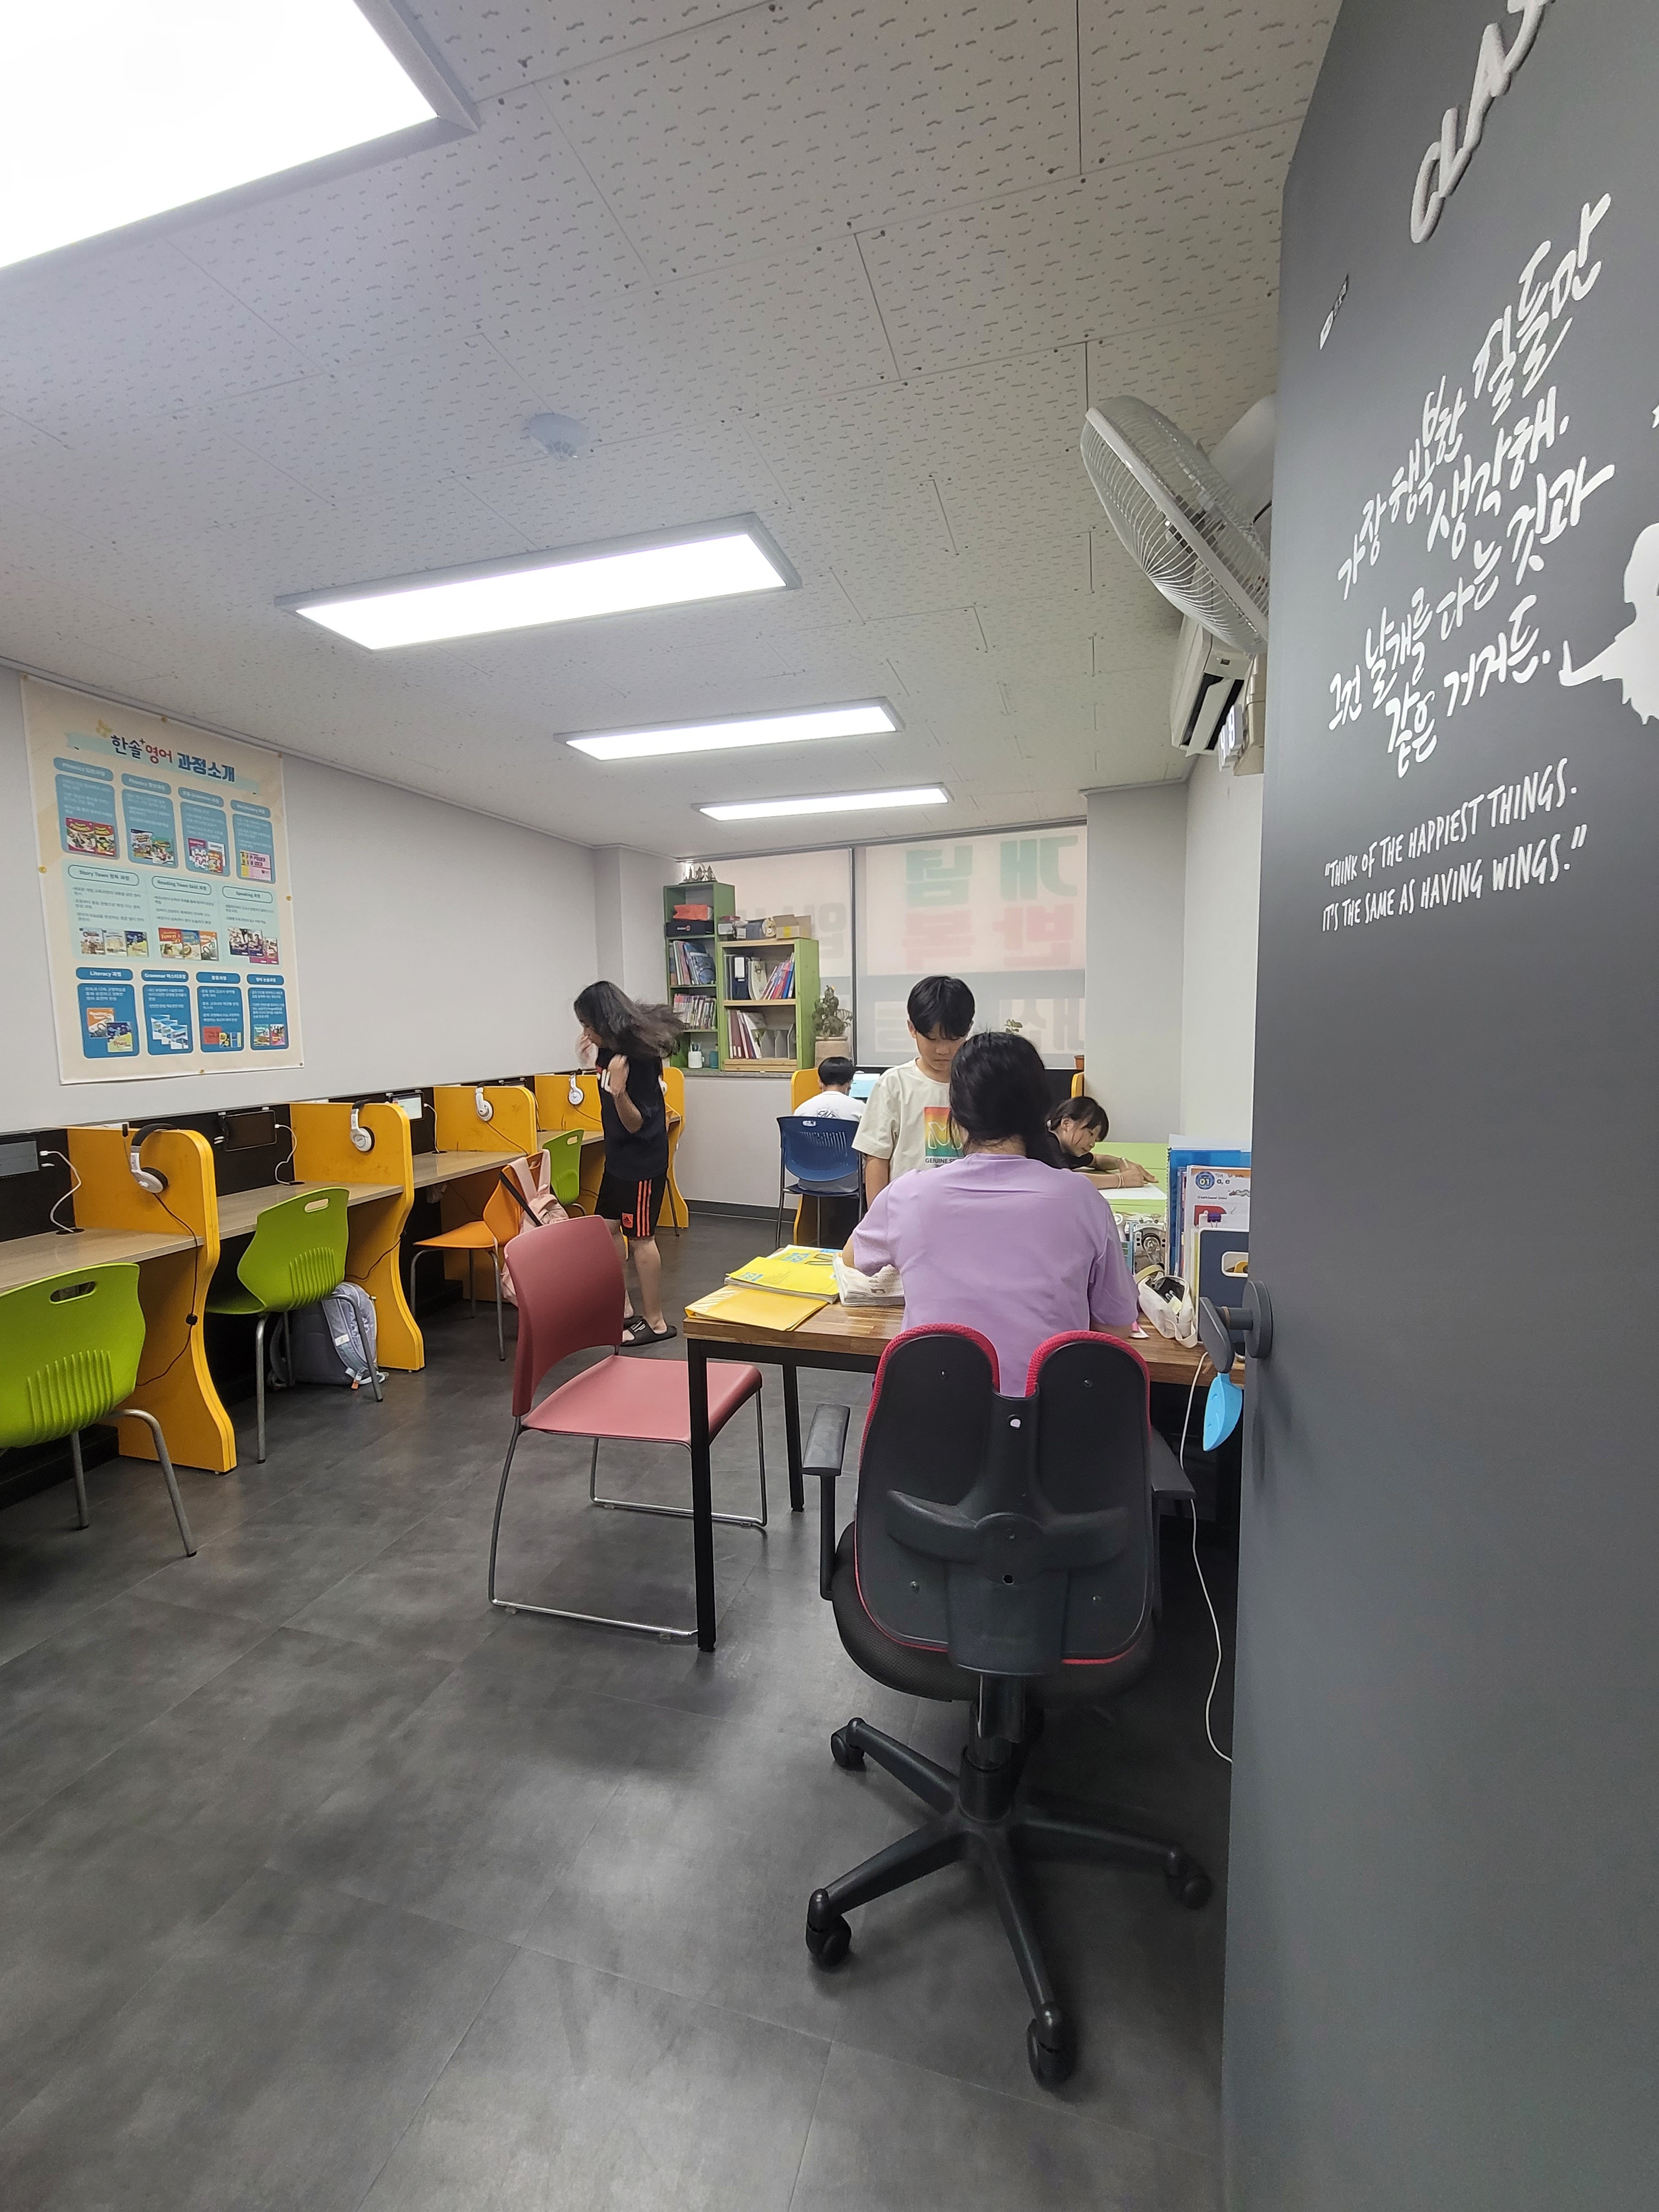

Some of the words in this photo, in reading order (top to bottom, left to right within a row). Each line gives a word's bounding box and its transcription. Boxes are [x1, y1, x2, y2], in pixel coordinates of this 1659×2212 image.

[1338, 493, 1387, 601] 가장
[1389, 375, 1467, 524] 행복한
[1427, 386, 1570, 560] 생각해.
[1329, 664, 1362, 730] 그건
[1365, 587, 1433, 709] 날개를
[1436, 540, 1503, 641] 다는
[1506, 456, 1615, 586] 것과
[177, 752, 235, 782] 과정소개
[1385, 681, 1437, 778] 같은
[1361, 841, 1378, 878] OF
[1379, 834, 1404, 868] THE
[1408, 794, 1485, 859] HAPPIEST
[1486, 758, 1577, 827] THINGS.
[1322, 902, 1339, 932] IT'S
[1341, 898, 1362, 927] THE
[1364, 888, 1396, 924] SAME
[1398, 878, 1415, 915] AS
[1420, 859, 1483, 909] HAVING
[1199, 1178, 1210, 1186] 01
